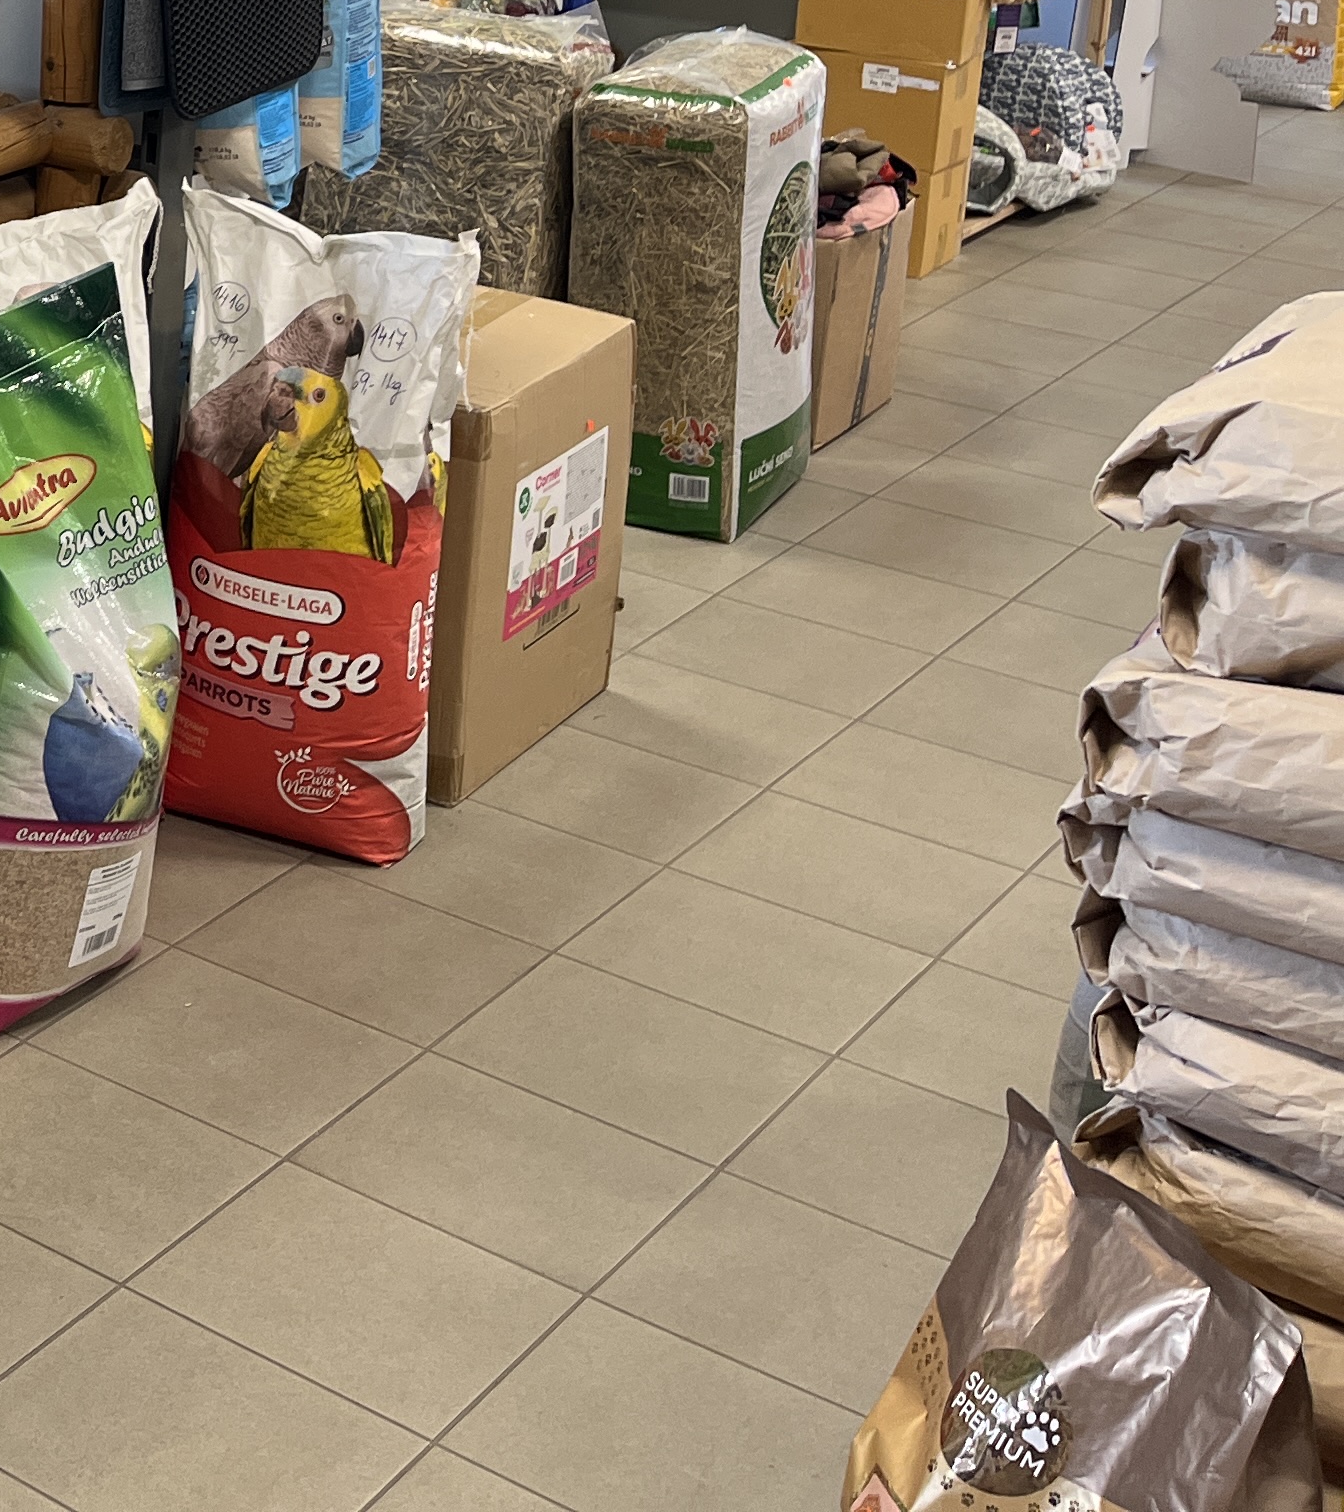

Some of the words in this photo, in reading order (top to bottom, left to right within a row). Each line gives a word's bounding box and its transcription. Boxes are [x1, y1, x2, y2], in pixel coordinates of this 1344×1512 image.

[1275, 0, 1319, 25] an
[57, 494, 158, 568] Budgie
[213, 572, 334, 616] VERSELE-LAGA
[282, 778, 337, 800] Nature
[15, 827, 95, 845] Carefully
[96, 823, 142, 843] selected
[964, 1370, 1022, 1431] SUPER
[950, 1391, 1046, 1479] PREMIUM
